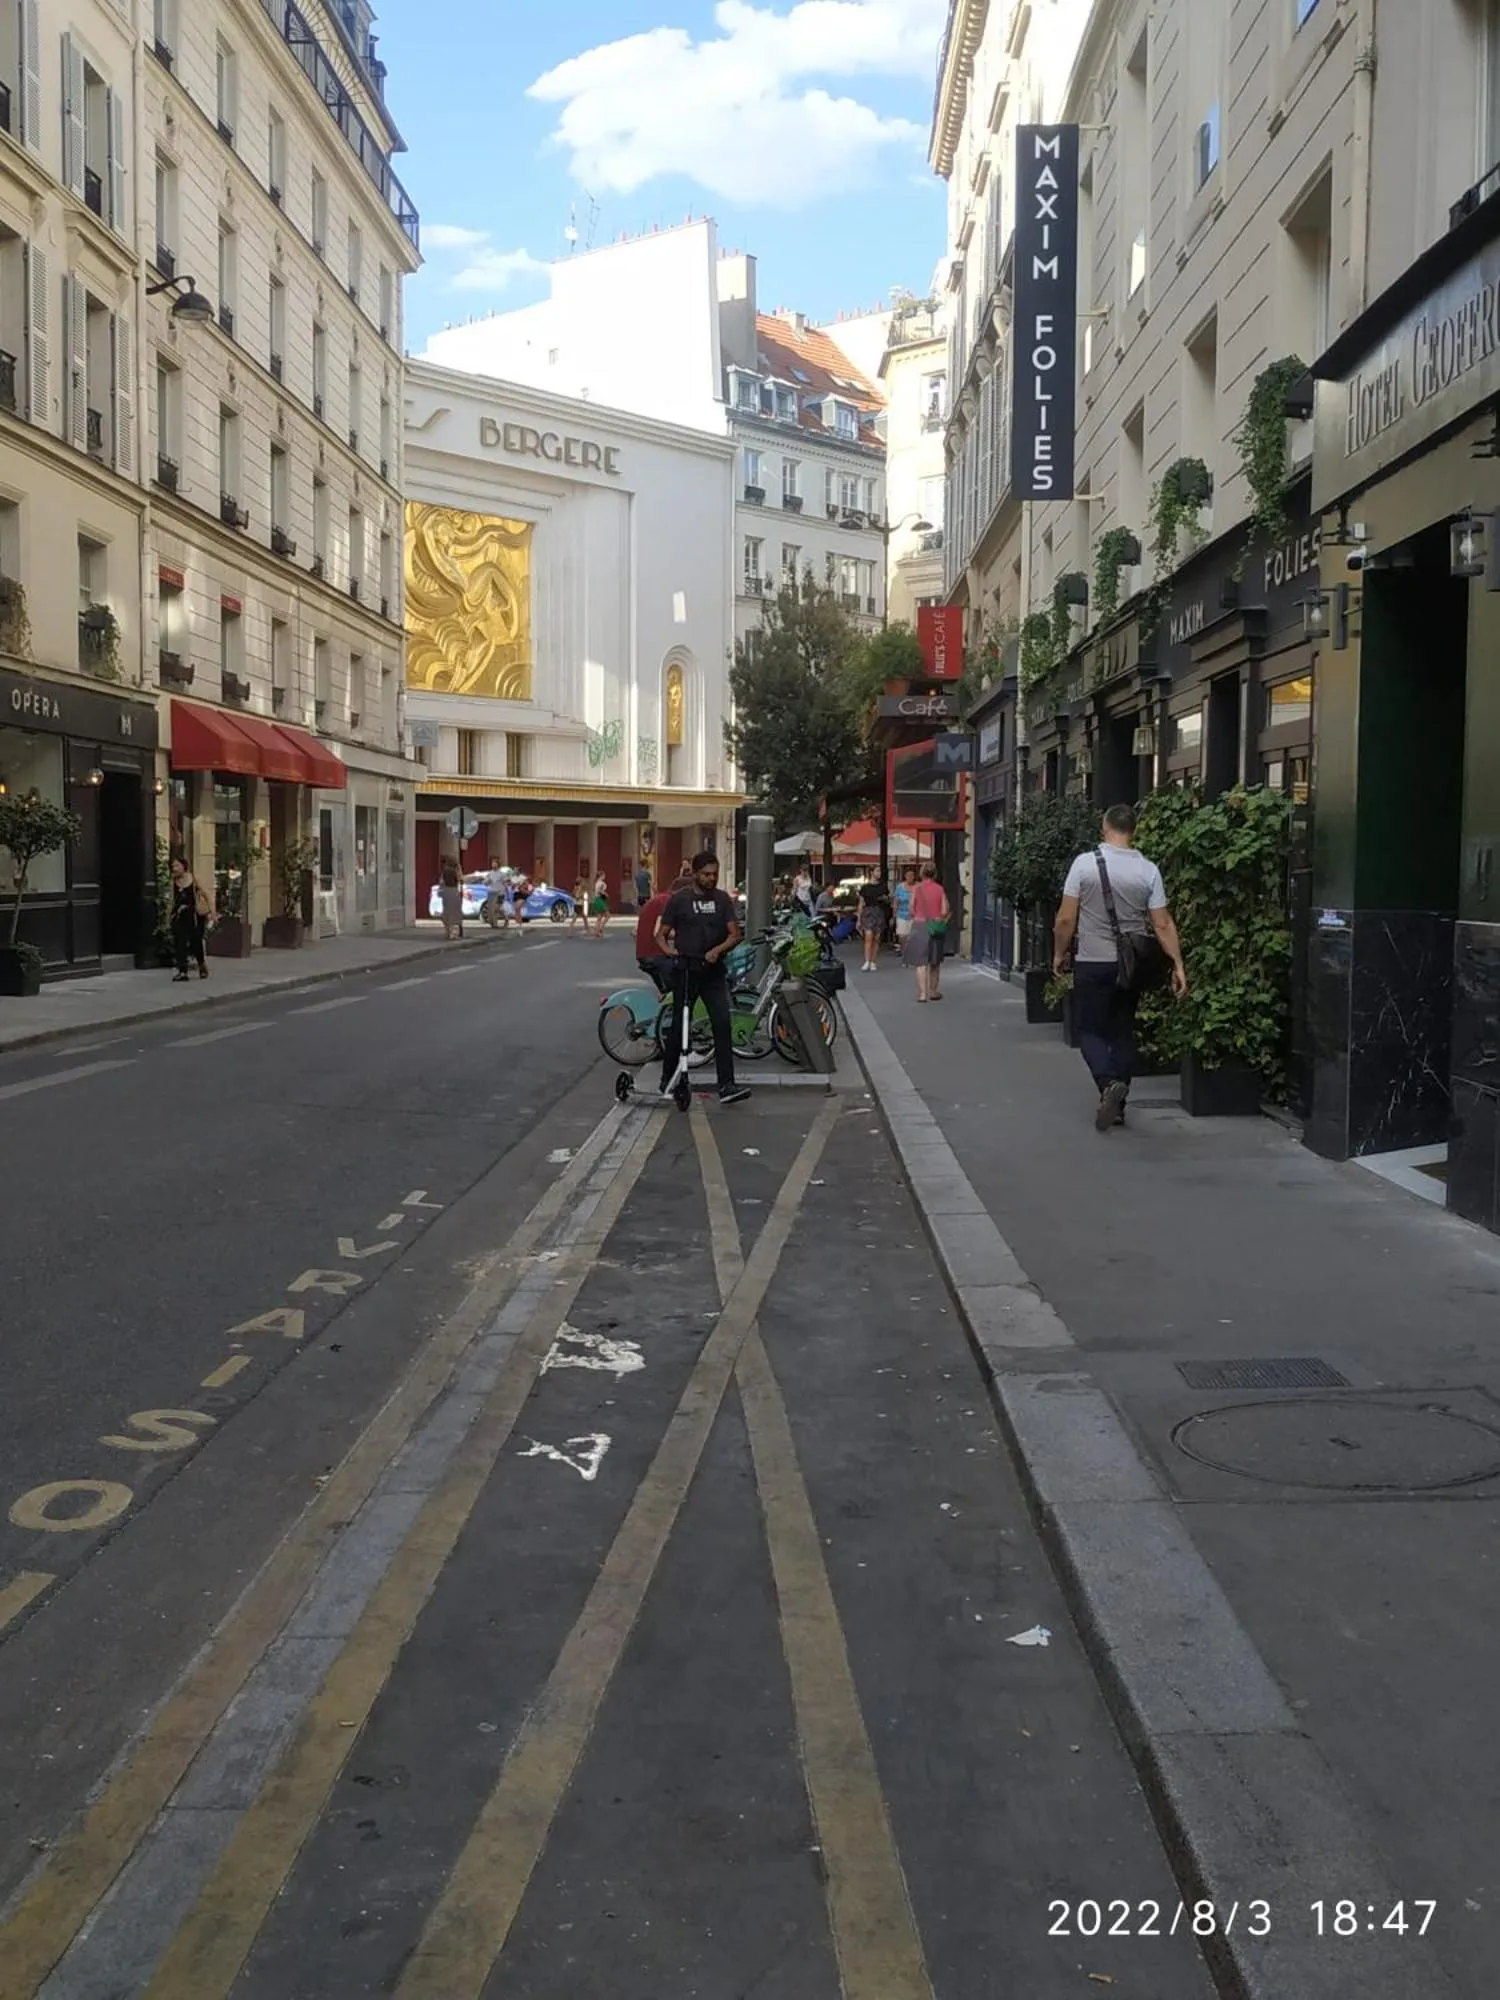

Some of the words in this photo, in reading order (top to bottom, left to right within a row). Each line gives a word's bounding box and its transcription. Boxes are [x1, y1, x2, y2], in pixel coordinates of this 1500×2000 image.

[1033, 135, 1060, 281] MAXIM
[1031, 314, 1057, 491] FOLIES
[1344, 359, 1403, 459] HOTEL
[1411, 279, 1500, 409] GEOFFR
[479, 416, 621, 474] BERGERE
[1170, 600, 1204, 645] MAXIM
[1264, 527, 1321, 592] FOLIES
[898, 698, 948, 717] Café
[937, 742, 970, 763] M
